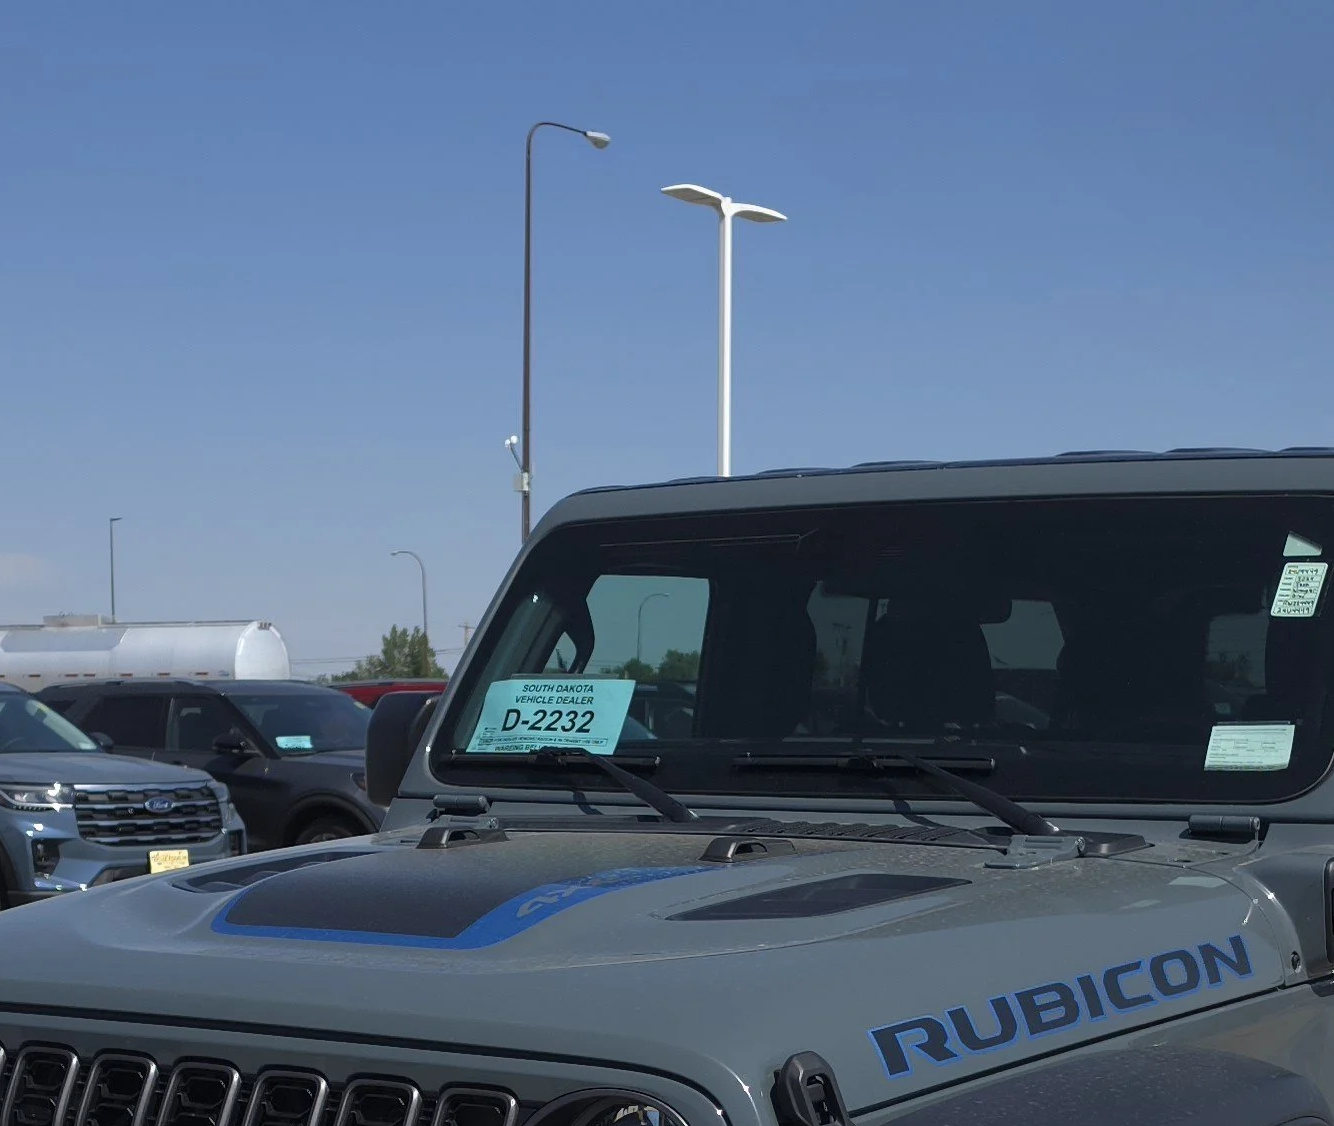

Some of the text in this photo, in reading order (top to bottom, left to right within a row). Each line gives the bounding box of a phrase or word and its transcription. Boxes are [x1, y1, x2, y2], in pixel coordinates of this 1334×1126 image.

[522, 684, 594, 693] SOUTH DAKOTA
[515, 695, 594, 705] VEHICLE DEALER
[501, 709, 595, 733] D-2232
[869, 934, 1255, 1079] RUBICON
